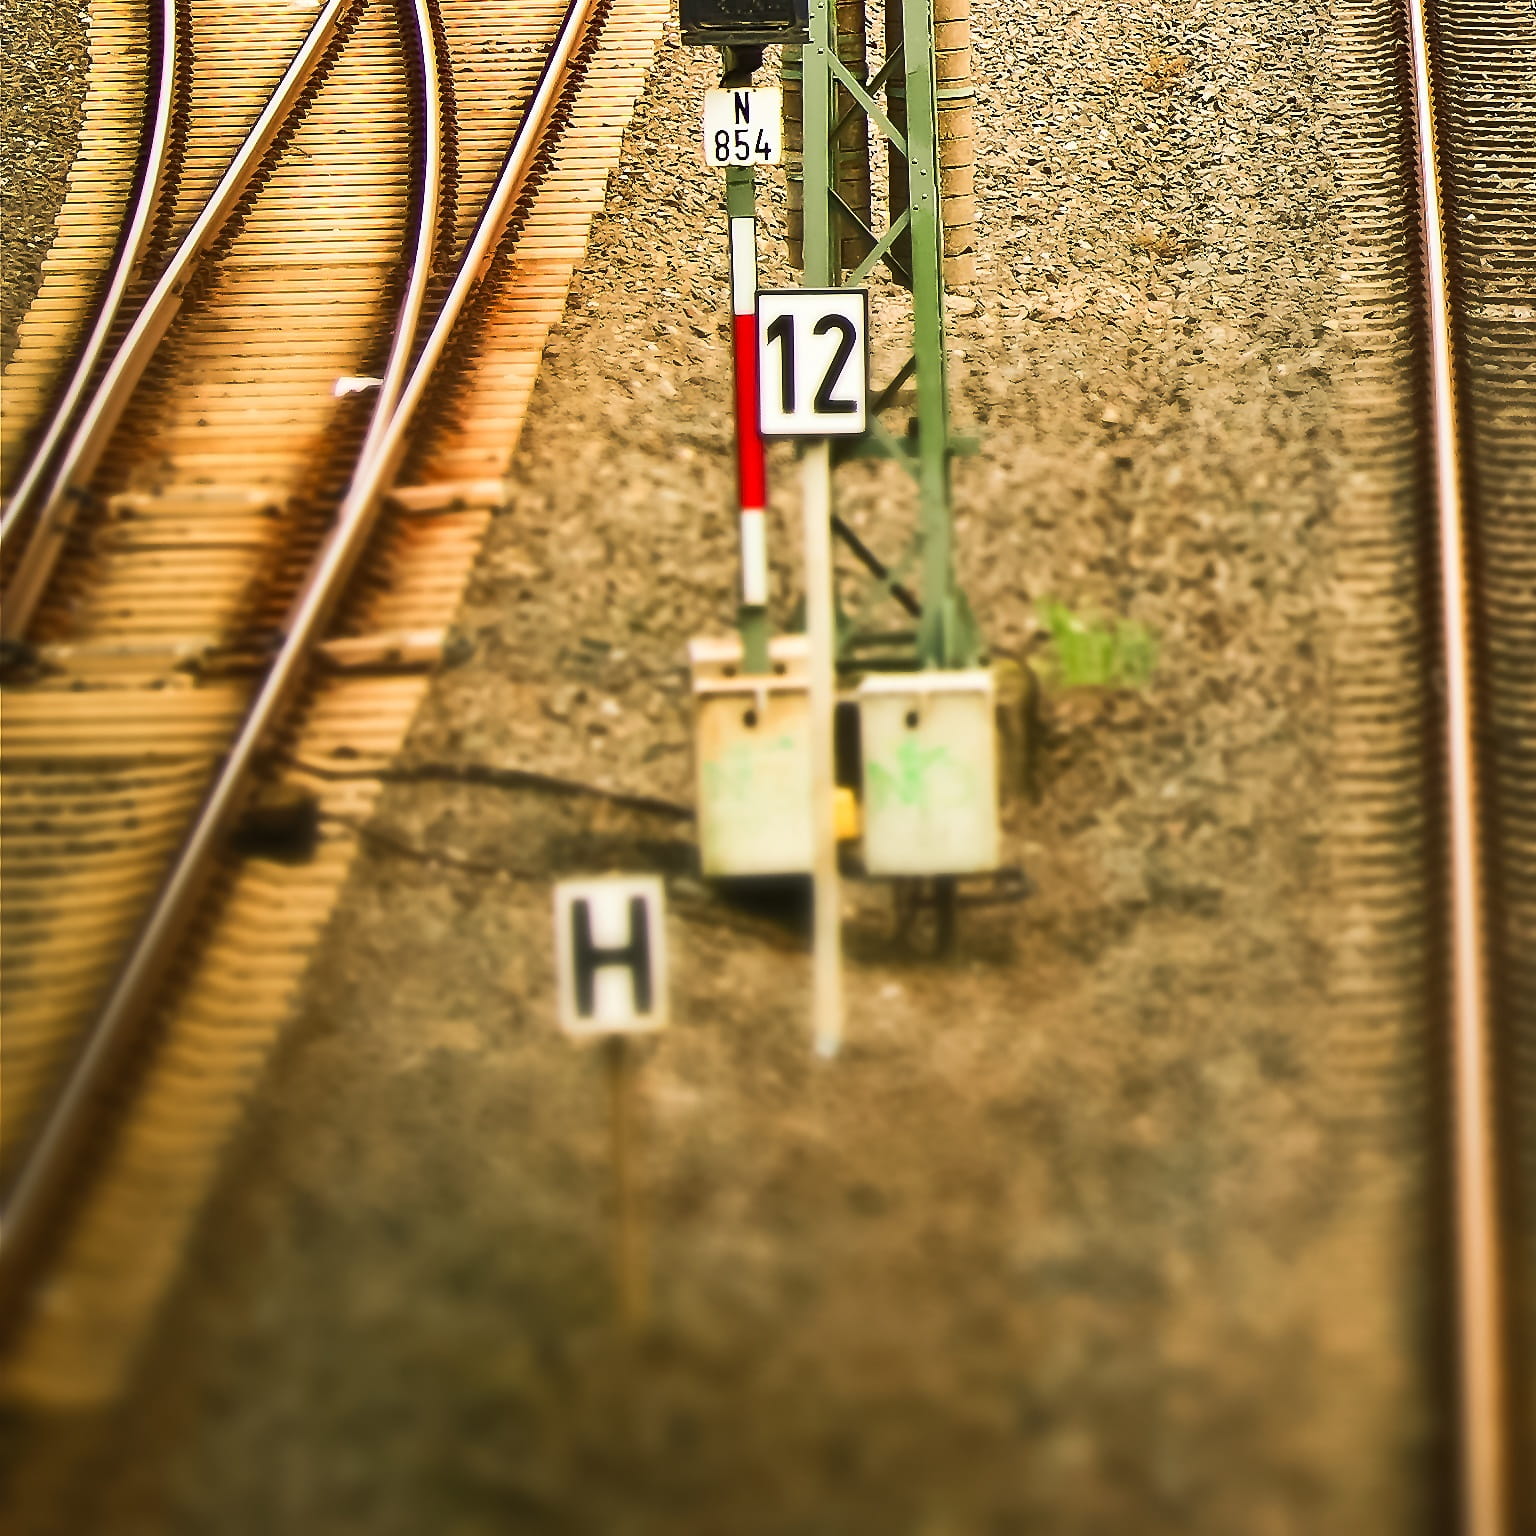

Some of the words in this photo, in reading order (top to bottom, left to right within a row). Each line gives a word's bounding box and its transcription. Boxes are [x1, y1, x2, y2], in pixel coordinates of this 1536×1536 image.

[735, 92, 749, 124] N
[715, 129, 771, 161] 854
[766, 314, 857, 414] 12
[572, 897, 652, 1018] H
